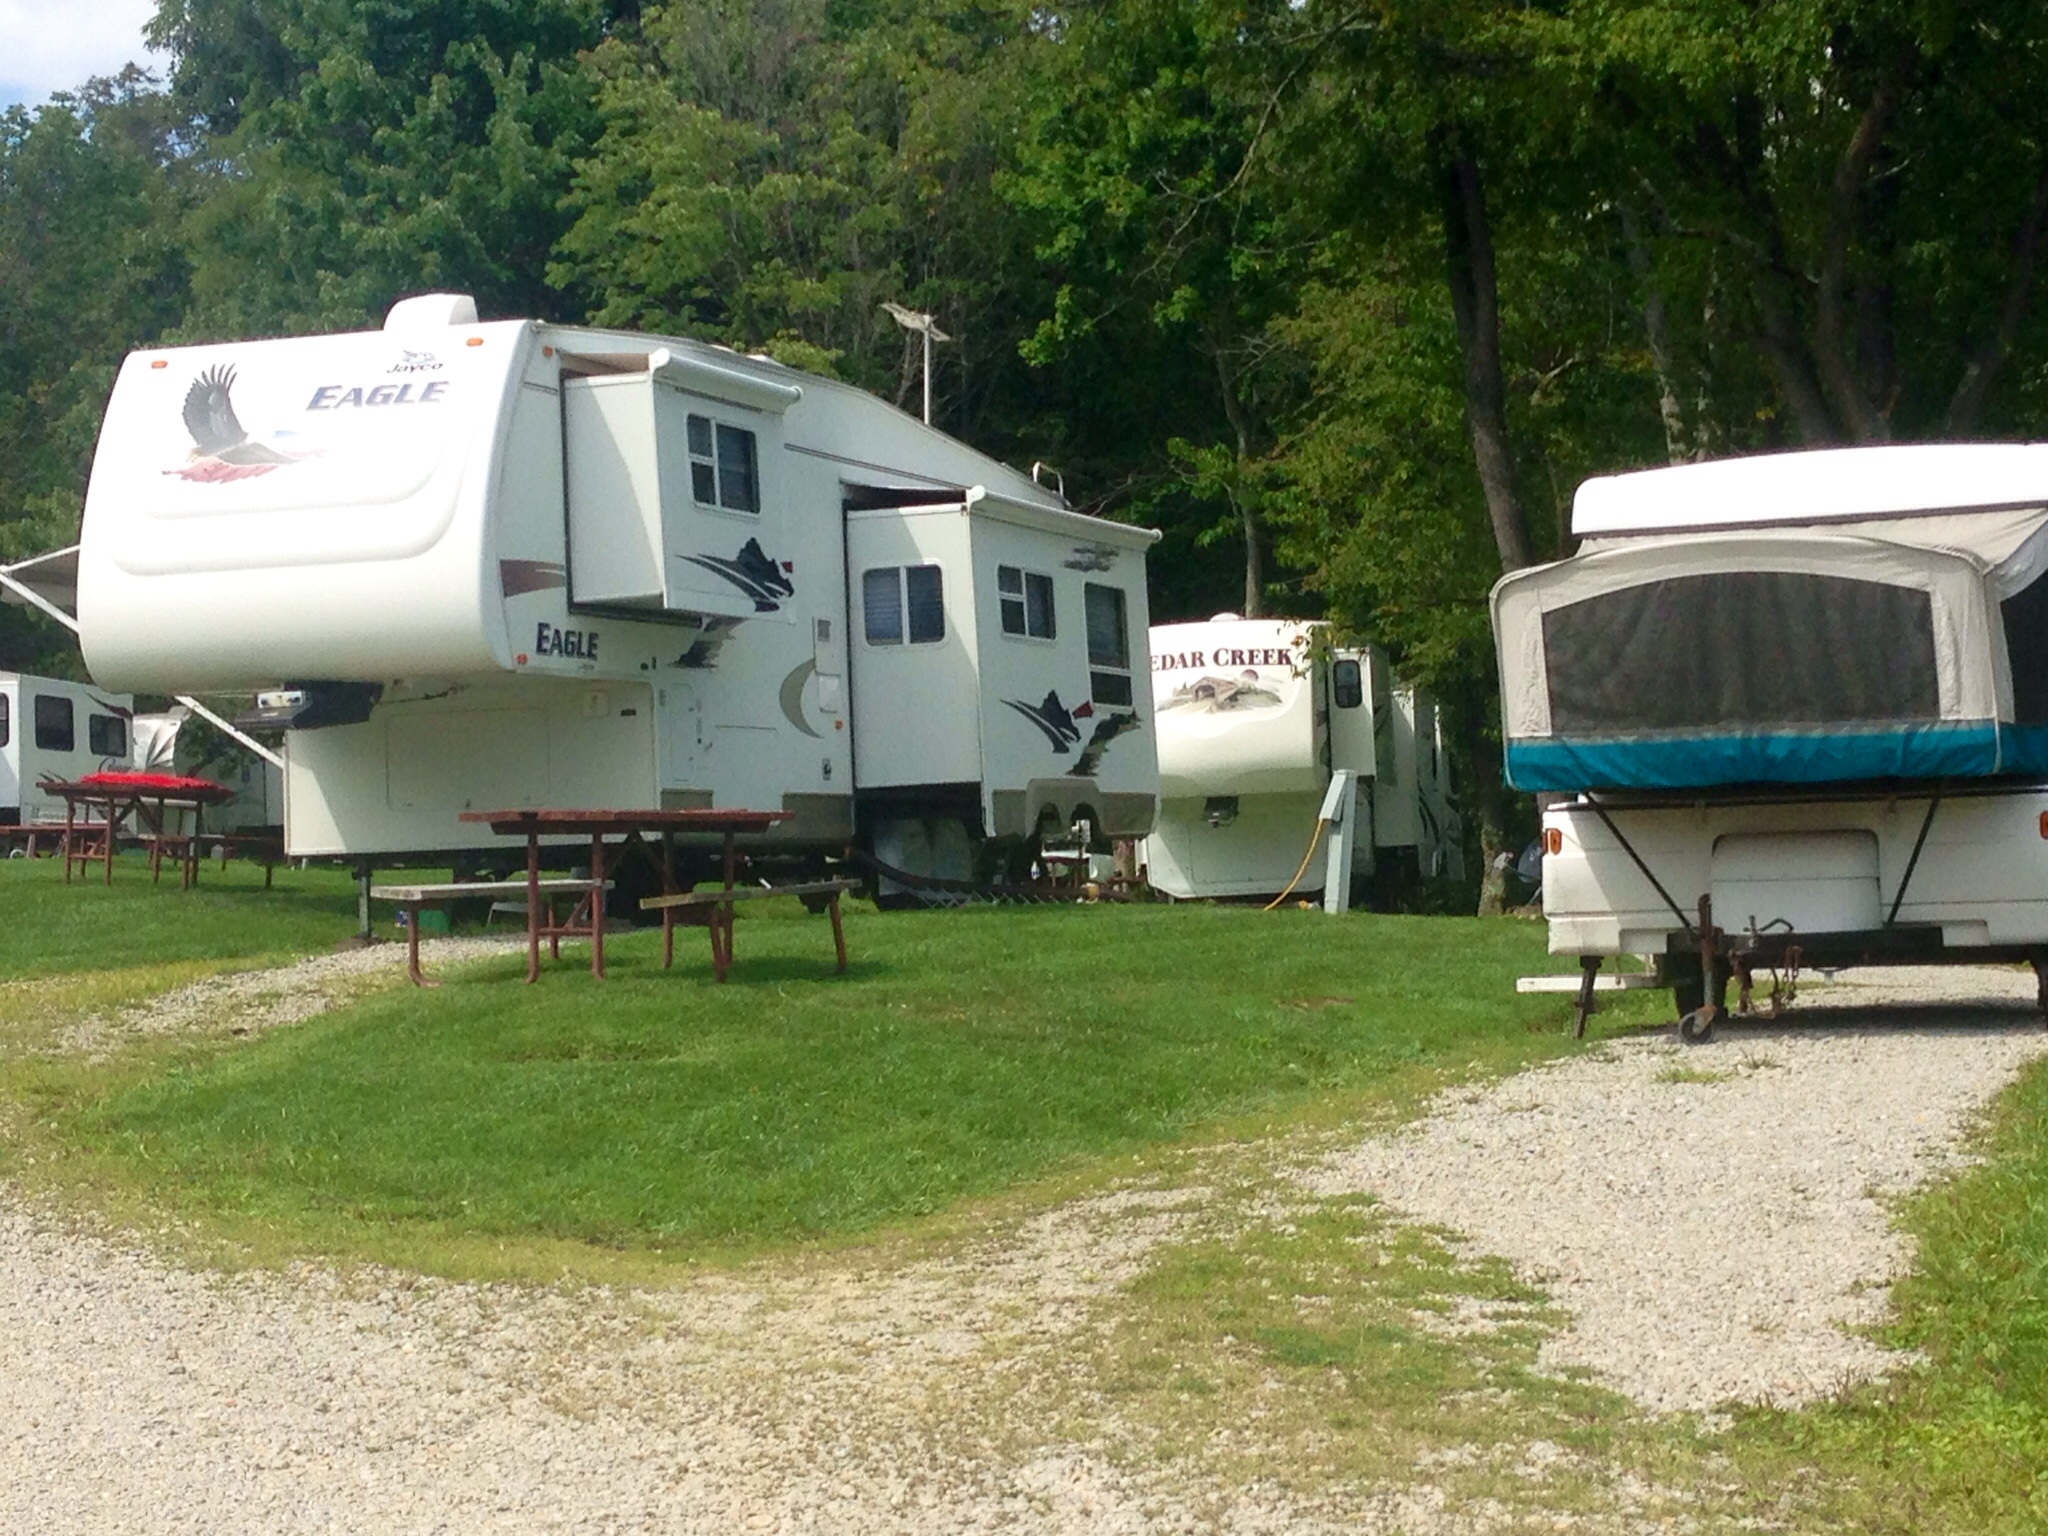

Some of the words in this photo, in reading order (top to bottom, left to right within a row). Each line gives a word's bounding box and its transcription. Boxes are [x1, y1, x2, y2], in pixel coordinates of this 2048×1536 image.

[386, 363, 443, 374] Jayco
[306, 381, 450, 411] EAGLE
[536, 622, 599, 661] EAGLE
[1150, 651, 1206, 672] EDAR
[1213, 648, 1291, 667] CREEK
